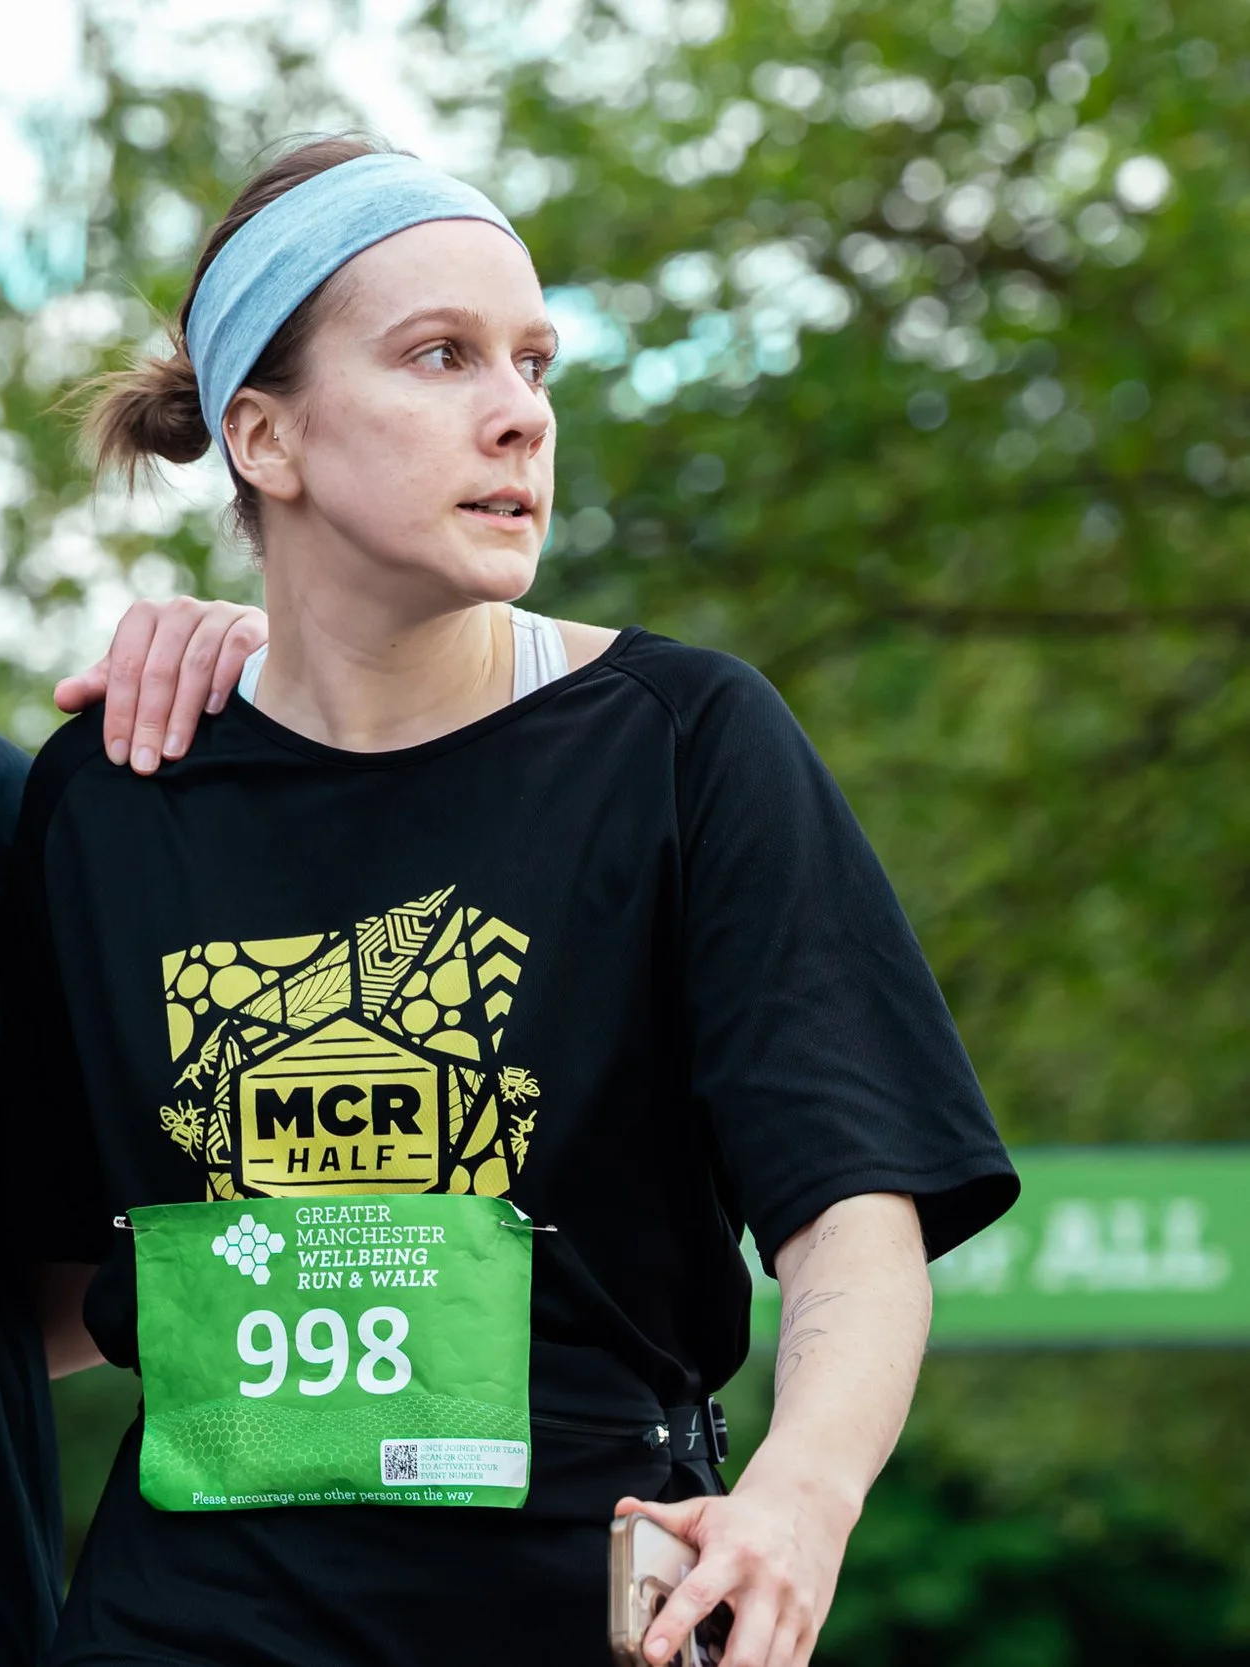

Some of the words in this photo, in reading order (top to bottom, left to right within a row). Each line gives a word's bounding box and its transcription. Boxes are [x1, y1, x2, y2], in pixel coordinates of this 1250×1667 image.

[255, 1083, 423, 1141] MCR
[287, 1145, 396, 1174] HALF
[296, 1205, 392, 1225] GREATER
[296, 1226, 446, 1247] MANCHESTER
[297, 1248, 428, 1268] WELLBEING
[297, 1271, 344, 1290] RUN
[349, 1271, 363, 1288] &
[370, 1269, 439, 1288] WALK
[236, 1306, 412, 1399] 998
[443, 1454, 455, 1462] QR
[479, 1445, 501, 1453] YOUR
[503, 1446, 524, 1454] TEAM
[448, 1472, 484, 1480] NUMBER
[476, 1463, 499, 1471] YOUR
[192, 1492, 227, 1505] Please
[230, 1492, 295, 1504] encourage
[298, 1492, 321, 1501] one
[324, 1489, 356, 1500] other
[359, 1491, 401, 1503] person
[404, 1491, 421, 1500] on
[423, 1488, 443, 1501] the
[446, 1491, 474, 1503] way
